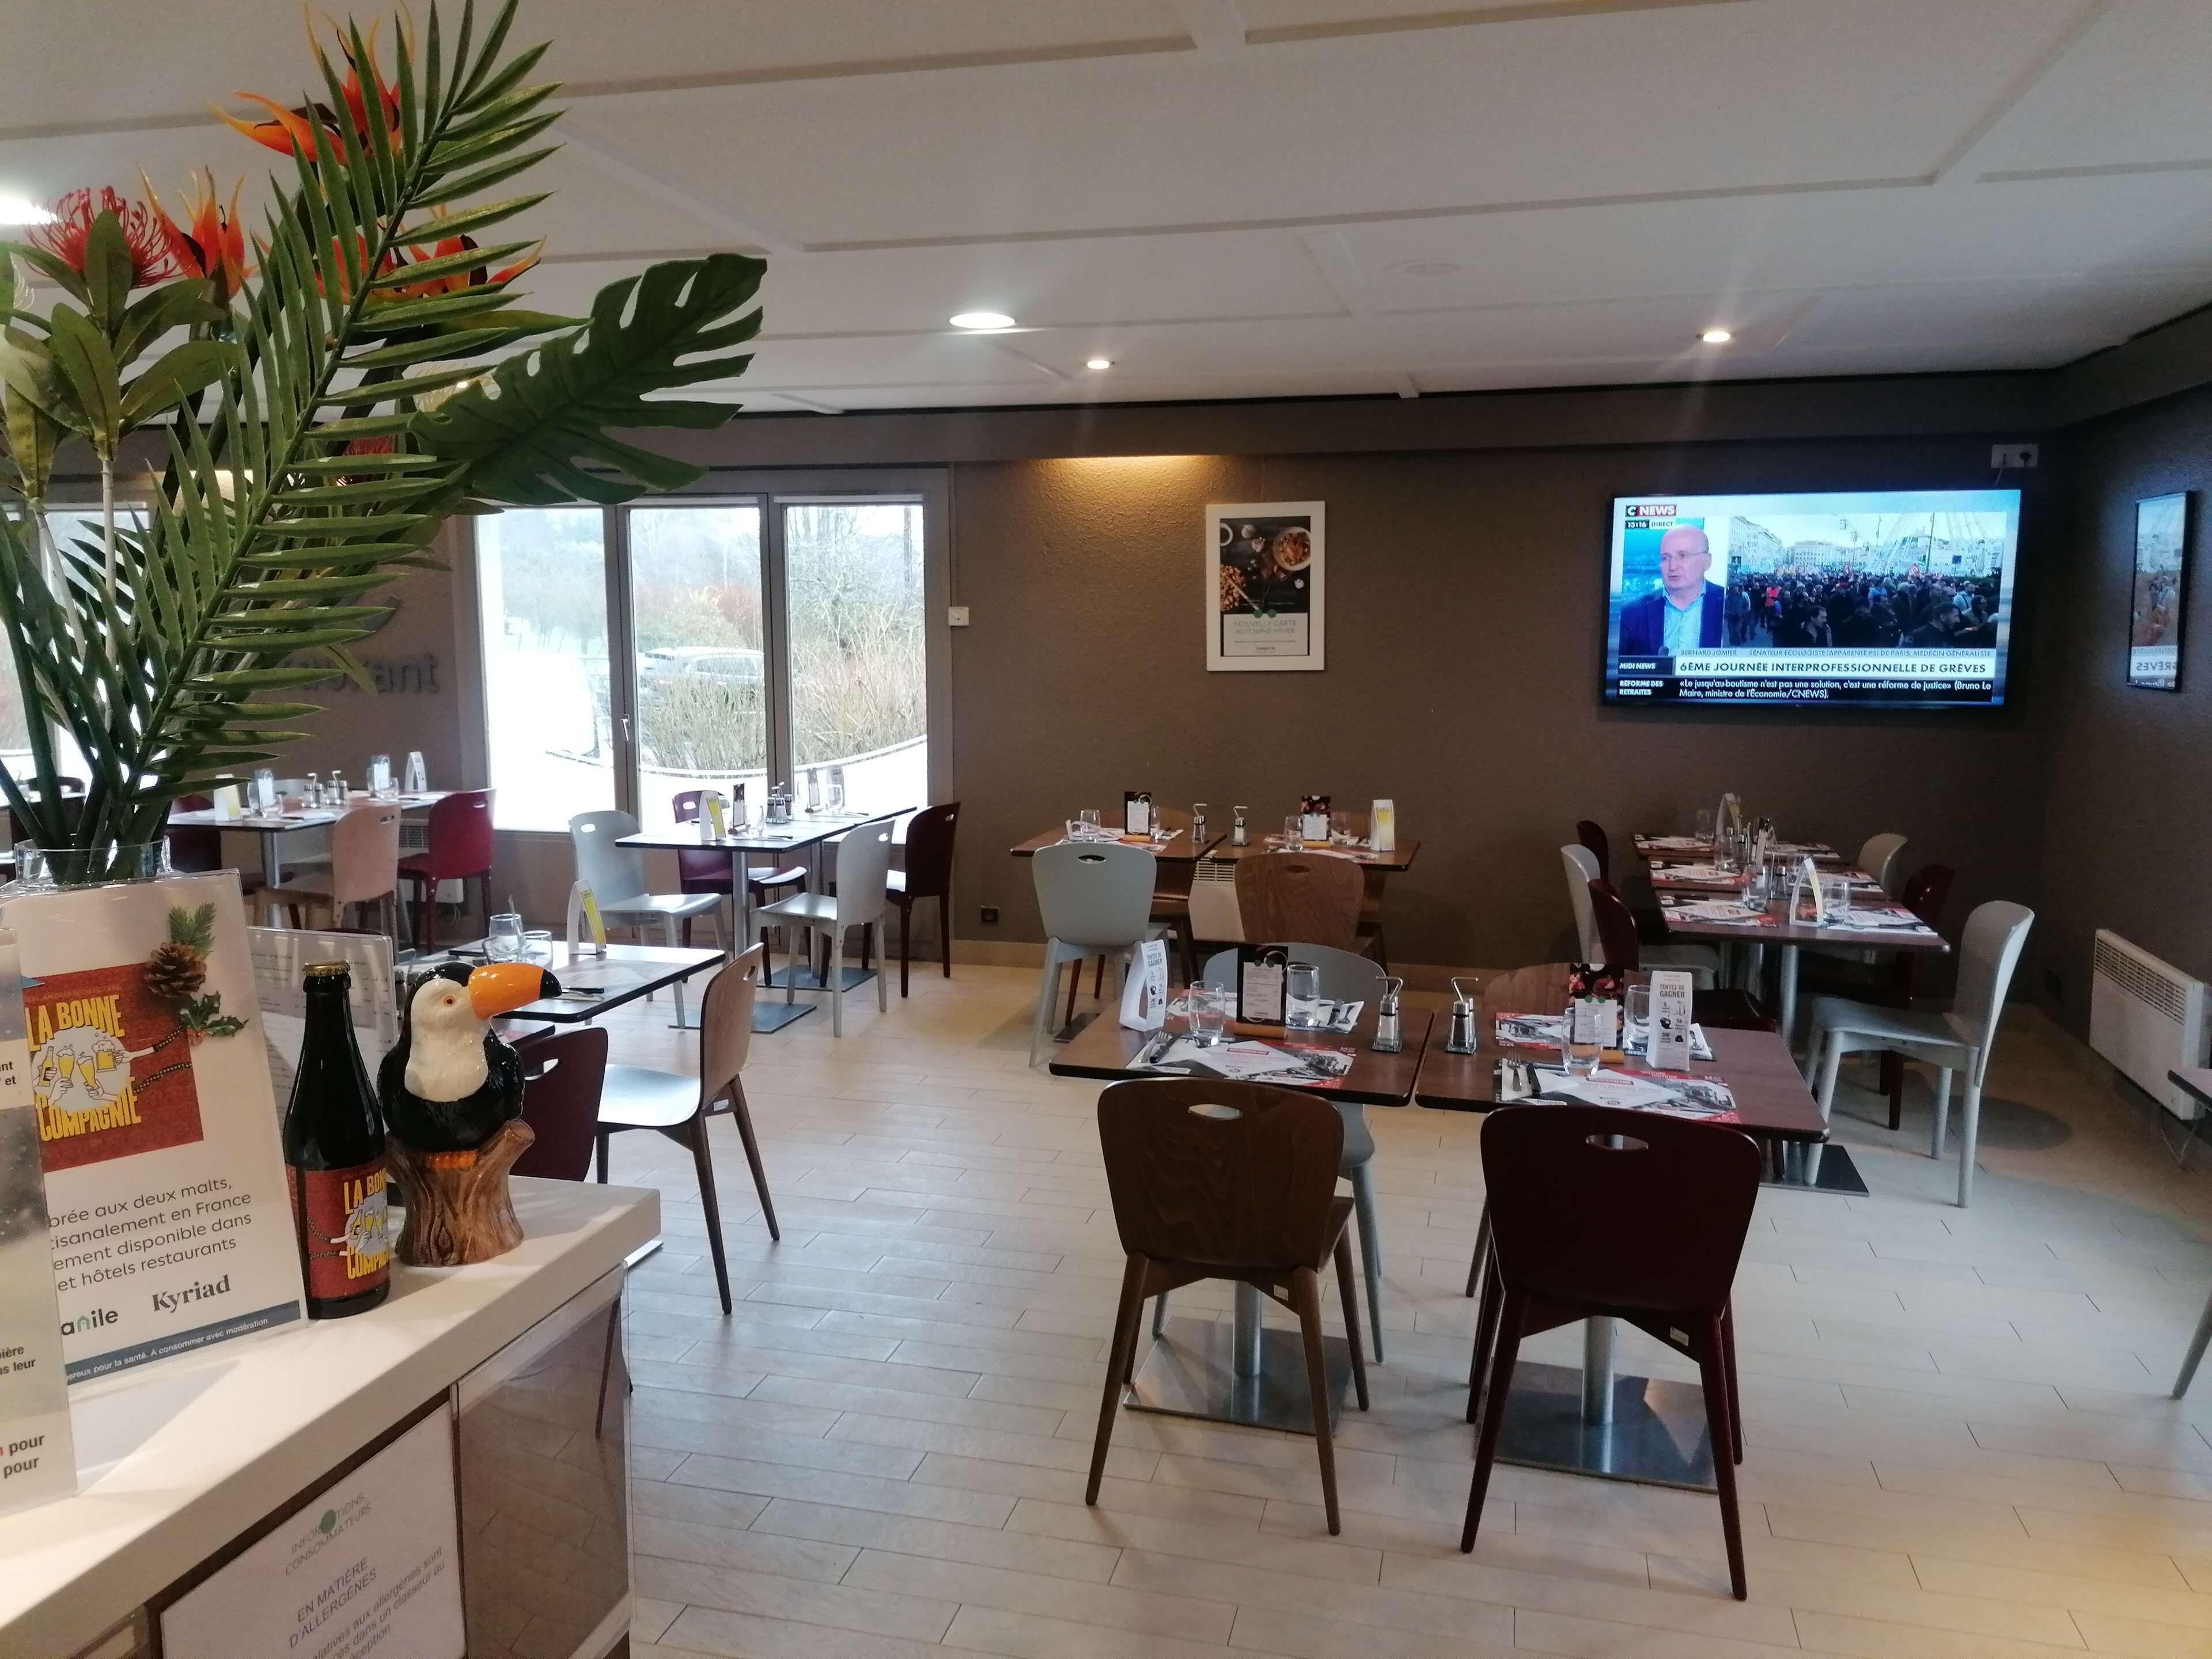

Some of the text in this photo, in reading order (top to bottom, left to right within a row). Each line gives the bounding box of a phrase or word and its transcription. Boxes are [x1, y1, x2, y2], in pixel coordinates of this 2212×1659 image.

[1714, 662, 1768, 672] JOURNÉE
[1771, 663, 1917, 673] INTERPROFESSIONNELLE
[1921, 664, 1936, 673] DE
[1779, 681, 1793, 690] pas
[1810, 680, 1841, 690] solution,
[1843, 680, 1860, 688] c'est
[1878, 680, 1909, 690] réforme
[1911, 681, 1922, 690] de
[1954, 680, 1980, 691] (Bruno
[1982, 681, 1991, 690] Le
[1679, 688, 1703, 698] Maire,
[1705, 689, 1733, 698] ministre
[1734, 690, 1745, 698] de
[1660, 990, 1685, 998] GAGNER
[25, 994, 126, 1052] LA BONNE
[5, 1075, 17, 1086] et
[35, 1076, 142, 1142] COMPAGNIE
[95, 1201, 129, 1217] aux
[133, 1191, 176, 1209] deux
[181, 1179, 232, 1198] malts,
[171, 1207, 191, 1221] en
[196, 1194, 252, 1215] France
[344, 1169, 387, 1215] LA BON
[54, 1214, 252, 1270] ement disponible dans
[58, 1238, 237, 1291] et hôtels restaurants
[151, 1274, 231, 1313] Kyriad
[13, 1358, 36, 1372] leur
[93, 1362, 113, 1374] pour
[114, 1359, 122, 1368] la
[158, 1336, 206, 1355] consommer
[206, 1330, 225, 1342] avec
[225, 1317, 268, 1335] modération
[9, 1435, 45, 1456] pour
[3, 1457, 40, 1479] pour
[285, 1502, 372, 1576] CONSOMMATEURS
[297, 1556, 368, 1623] EN MATIÈRE
[353, 1607, 371, 1631] aux
[423, 1546, 442, 1569] sont
[353, 1560, 445, 1646] dans un classeur au
